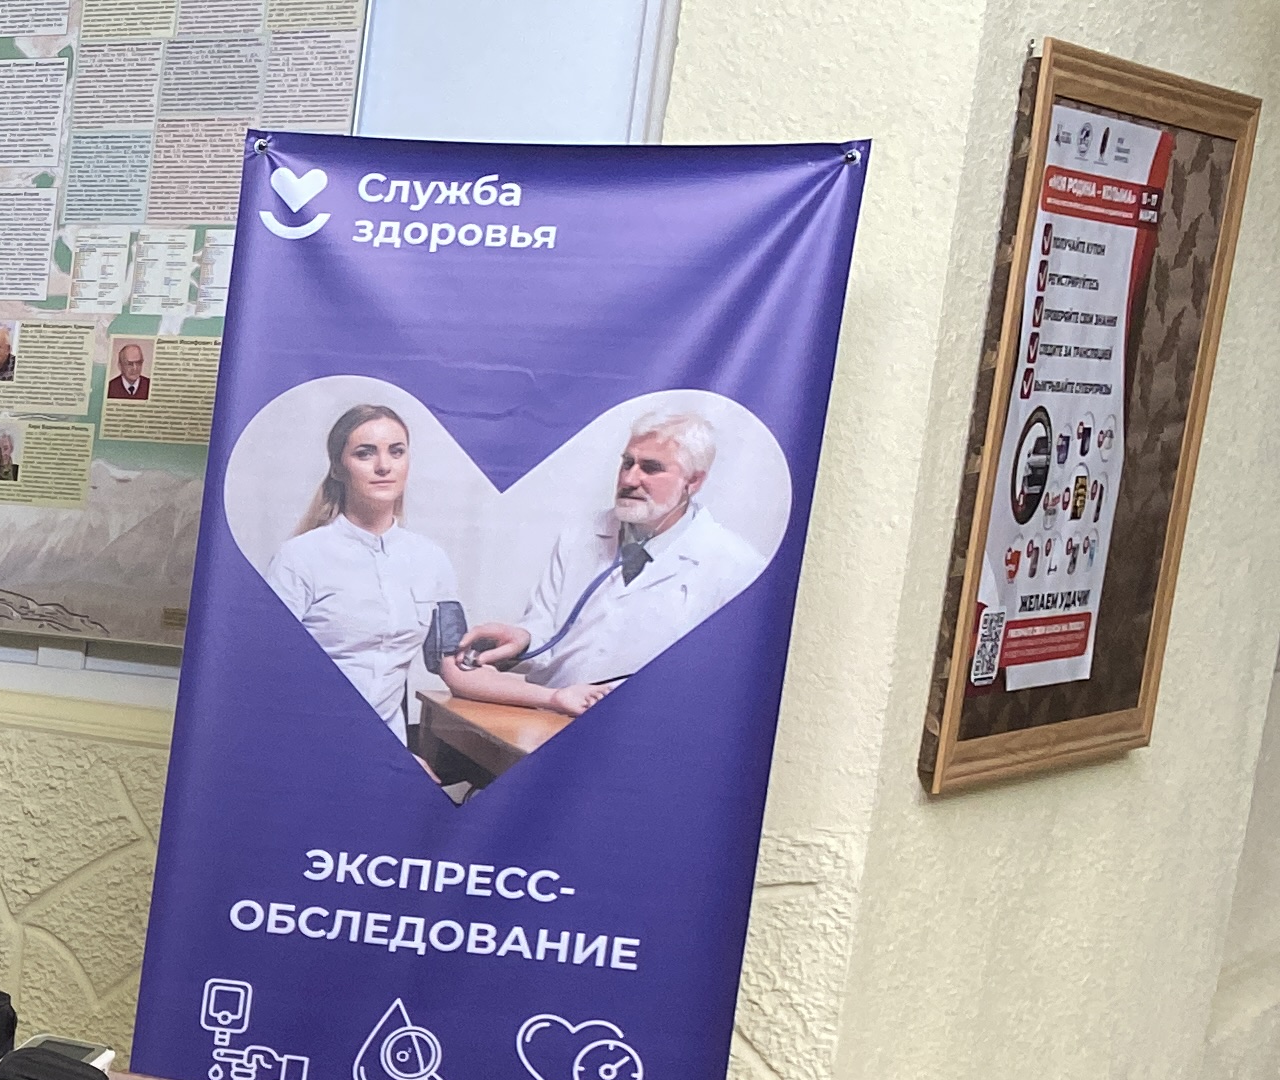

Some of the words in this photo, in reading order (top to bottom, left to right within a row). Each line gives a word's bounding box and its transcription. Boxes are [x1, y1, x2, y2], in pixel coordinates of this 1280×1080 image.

[357, 171, 523, 212] Служба
[352, 216, 558, 252] здоровья
[1019, 594, 1058, 613] ЖЕЛАЕМ
[302, 848, 576, 904] ЭКСПРЕСС-
[229, 900, 640, 971] ОБСЛЕДОВАНИЕ
